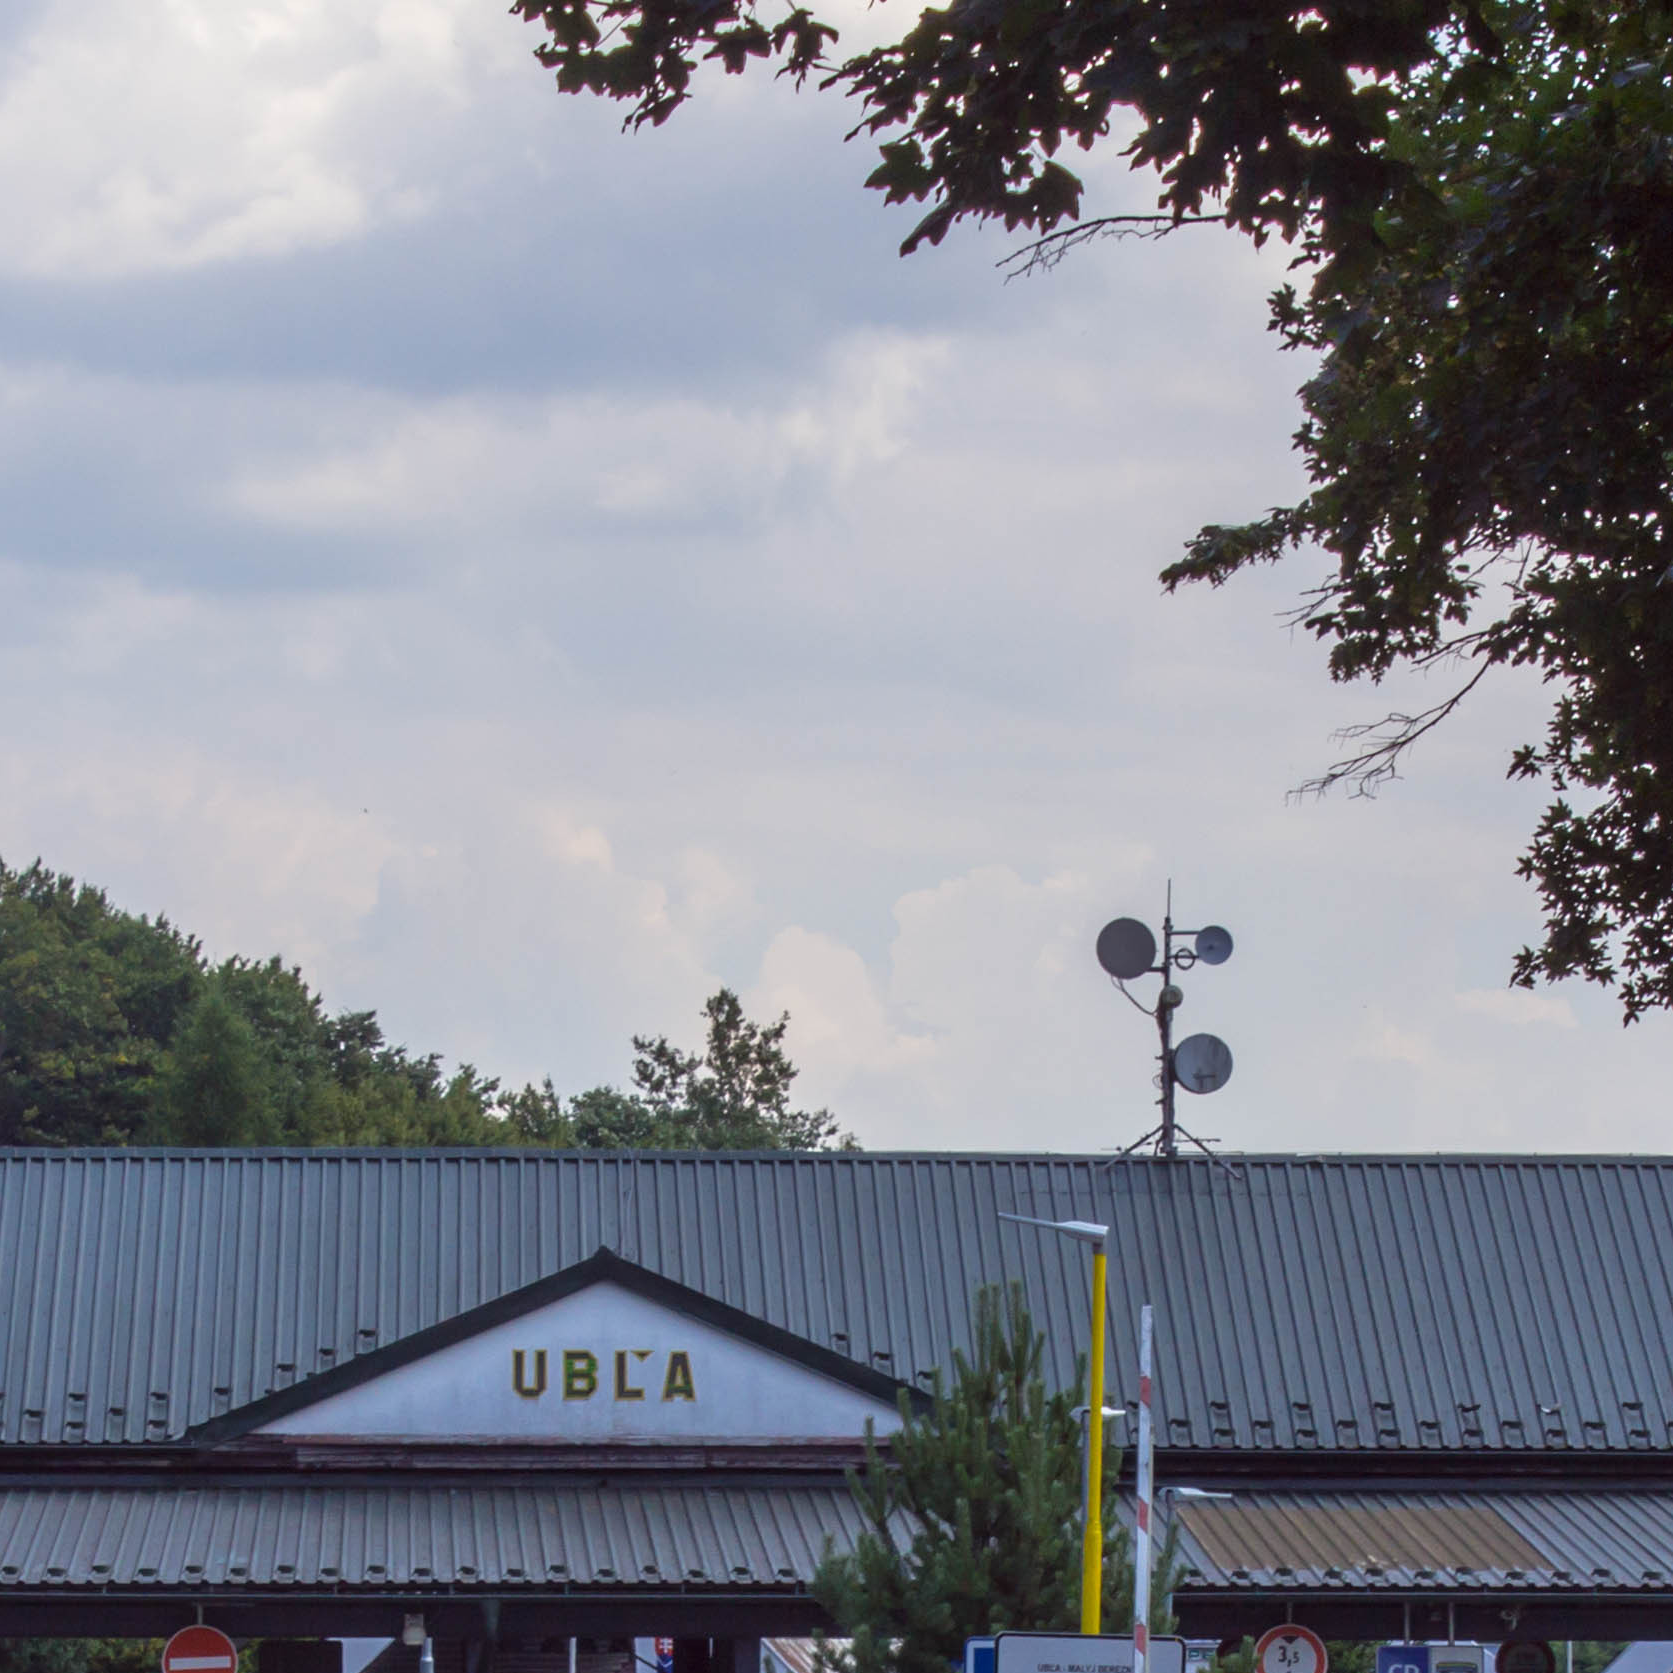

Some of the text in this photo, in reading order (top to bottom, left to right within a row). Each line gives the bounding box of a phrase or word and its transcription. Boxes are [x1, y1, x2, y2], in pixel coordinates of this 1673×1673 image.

[512, 1348, 697, 1403] UBĽA
[1278, 1645, 1300, 1667] 3,5
[1097, 1665, 1133, 1673] BEREZN
